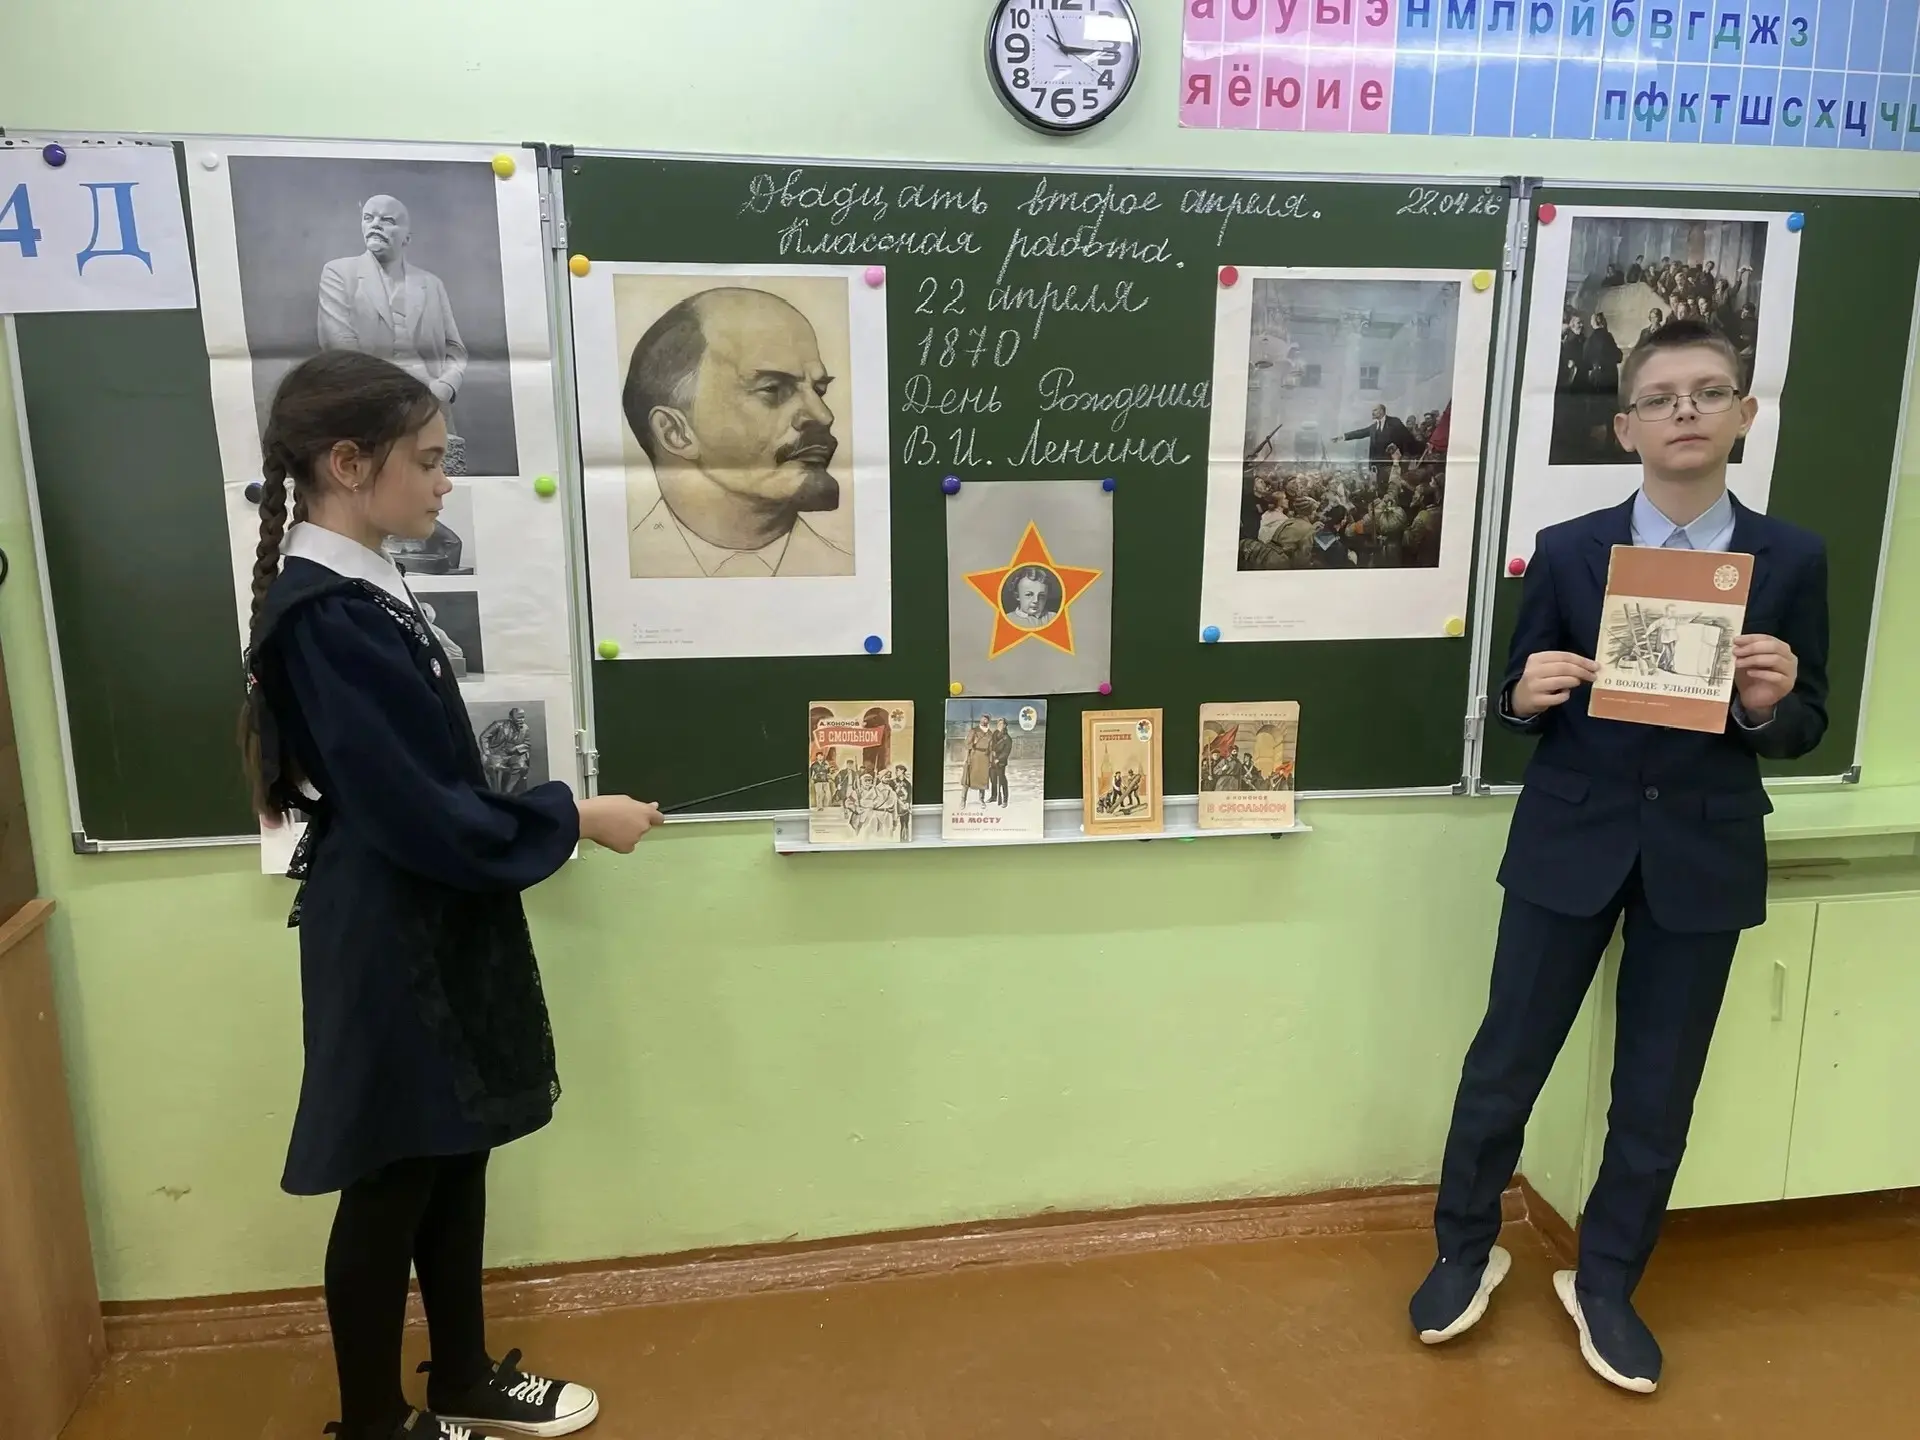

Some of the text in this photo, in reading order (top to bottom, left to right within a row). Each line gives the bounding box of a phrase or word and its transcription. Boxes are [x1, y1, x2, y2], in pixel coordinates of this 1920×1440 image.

[1010, 8, 1030, 29] 10
[1407, 0, 1429, 27] н
[1447, 0, 1476, 29] м
[1487, 1, 1515, 31] л
[1530, 2, 1553, 39] р
[1612, 0, 1634, 37] б
[1650, 9, 1673, 39] в
[1688, 12, 1705, 40] г
[1714, 13, 1741, 50] д
[1750, 15, 1780, 45] ж
[1790, 17, 1808, 46] з
[1004, 33, 1030, 63] 9
[1012, 68, 1030, 89] 8
[1097, 69, 1115, 90] 4
[1031, 87, 1047, 109] 7
[1051, 88, 1076, 118] 6
[1083, 88, 1098, 110] 5
[1186, 73, 1211, 105] я
[1228, 64, 1251, 107] ё
[1265, 77, 1299, 108] ю
[1316, 79, 1340, 109] и
[1360, 79, 1383, 111] е
[1604, 90, 1627, 120] п
[1635, 81, 1668, 131] ф
[1678, 93, 1699, 123] к
[1711, 94, 1730, 124] т
[1740, 95, 1772, 125] ш
[1783, 97, 1802, 127] с
[1814, 99, 1837, 128] х
[1845, 101, 1866, 137] ц
[1881, 102, 1899, 131] ч
[1017, 176, 1163, 244] второе
[0, 182, 153, 276] 4 Д
[778, 217, 982, 255] Классная
[915, 277, 1149, 340] 22 апреля
[918, 326, 1021, 367] 1870
[902, 367, 1211, 432] День Рождения
[1008, 418, 1191, 466] Ленина
[1616, 679, 1657, 690] ВОЛОДЕ
[1663, 684, 1721, 697] УЛЬЯНОВЕ
[819, 730, 878, 743] В СМОЛЬНОМ
